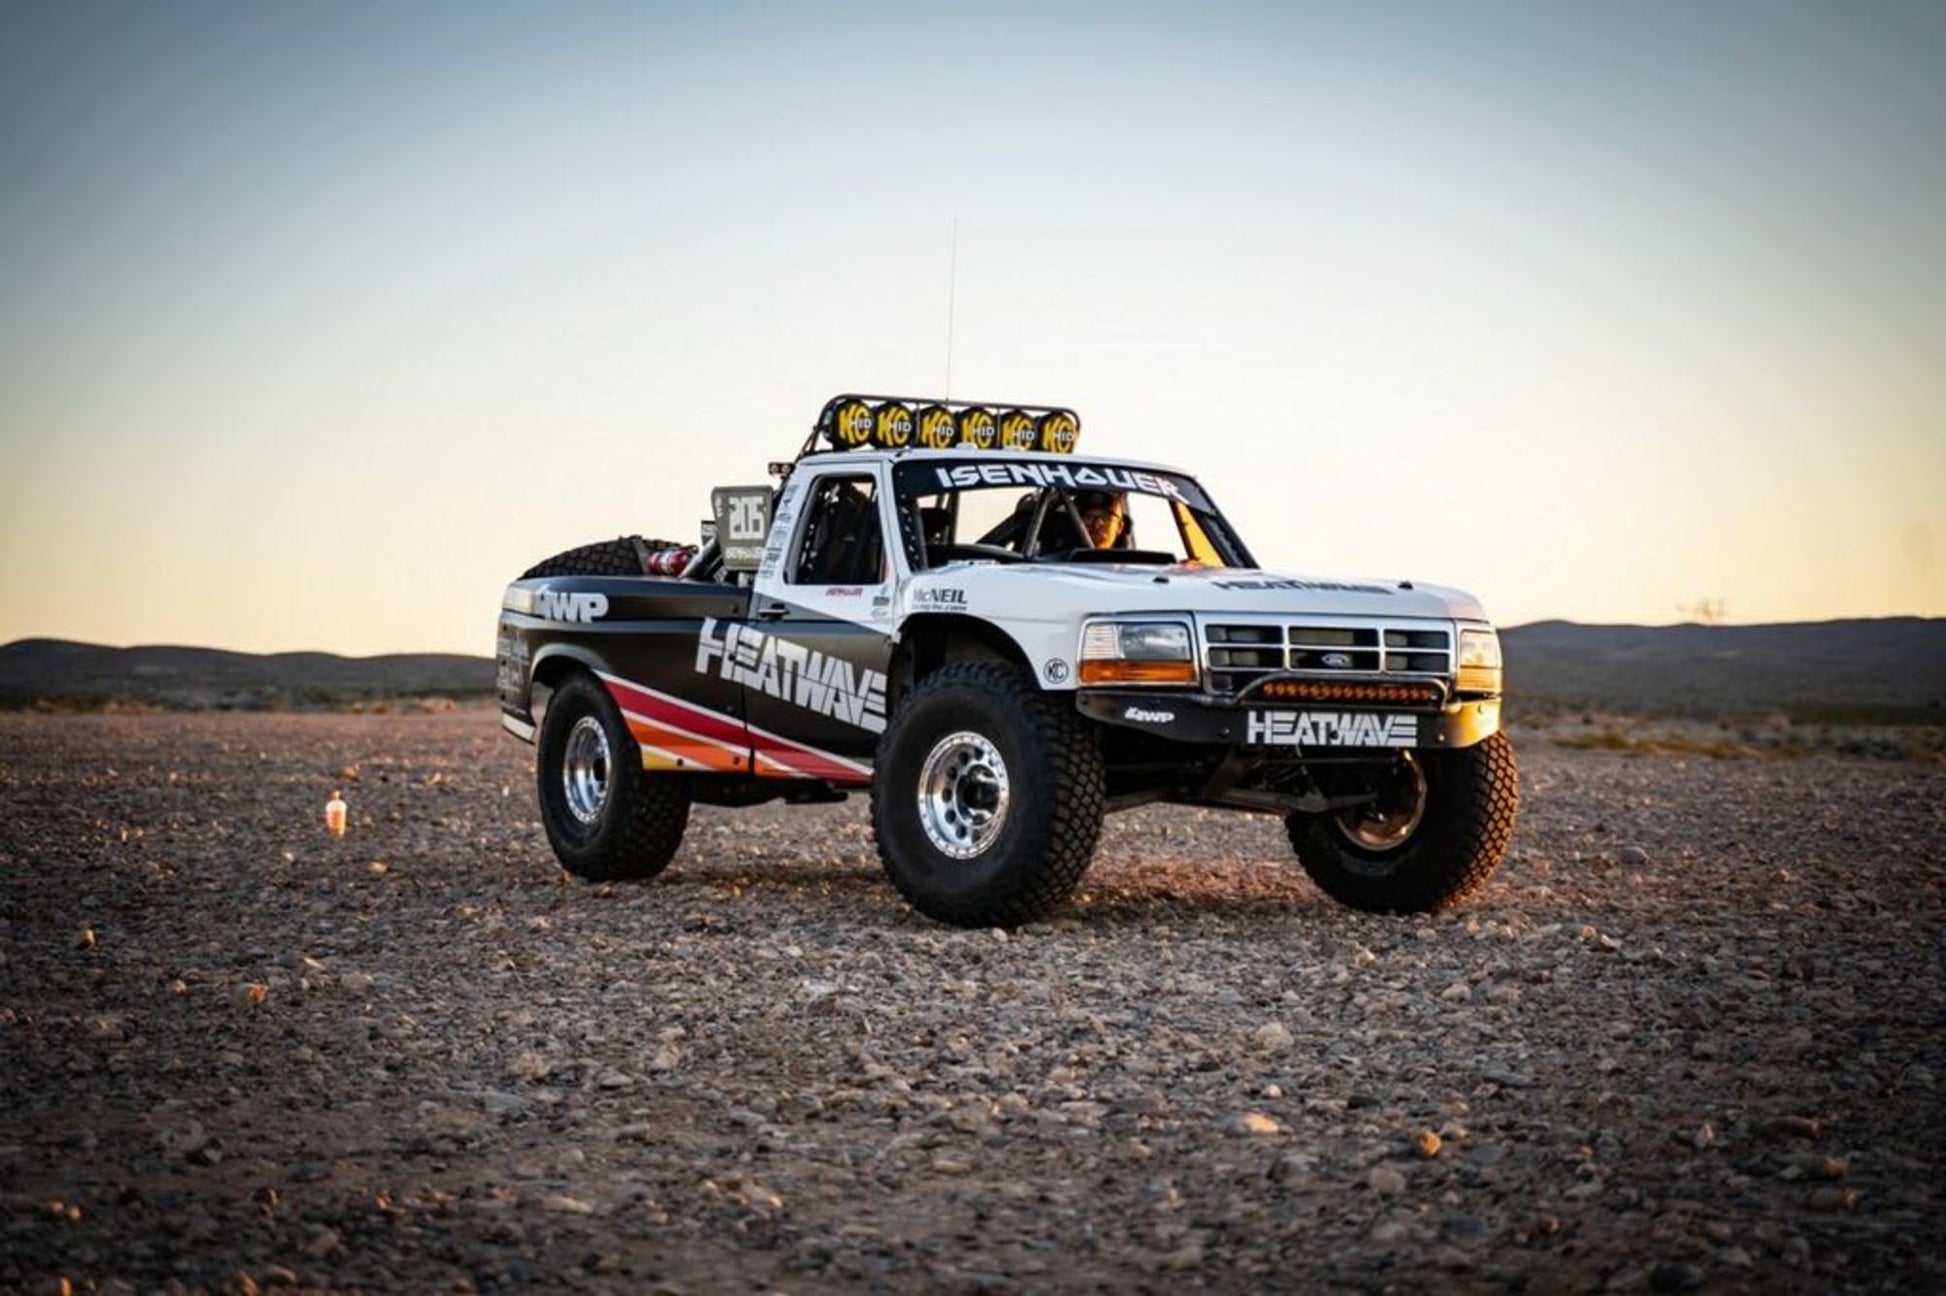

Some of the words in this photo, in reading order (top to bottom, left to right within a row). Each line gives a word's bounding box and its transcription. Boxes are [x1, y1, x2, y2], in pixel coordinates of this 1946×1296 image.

[839, 403, 870, 443] KC
[850, 418, 872, 430] HID
[877, 407, 909, 445] KC
[889, 421, 911, 432] HID
[921, 410, 953, 448] KC
[933, 425, 955, 437] HID
[963, 410, 993, 449] KC
[973, 426, 994, 437] HID
[1003, 415, 1033, 450] KC
[1013, 430, 1035, 441] HID
[1043, 416, 1073, 453] KC
[1052, 431, 1075, 442] HID
[934, 463, 1191, 505] ISENHAUER
[695, 616, 888, 735] HEATWAVE
[1247, 710, 1417, 747] HEATWAVE
